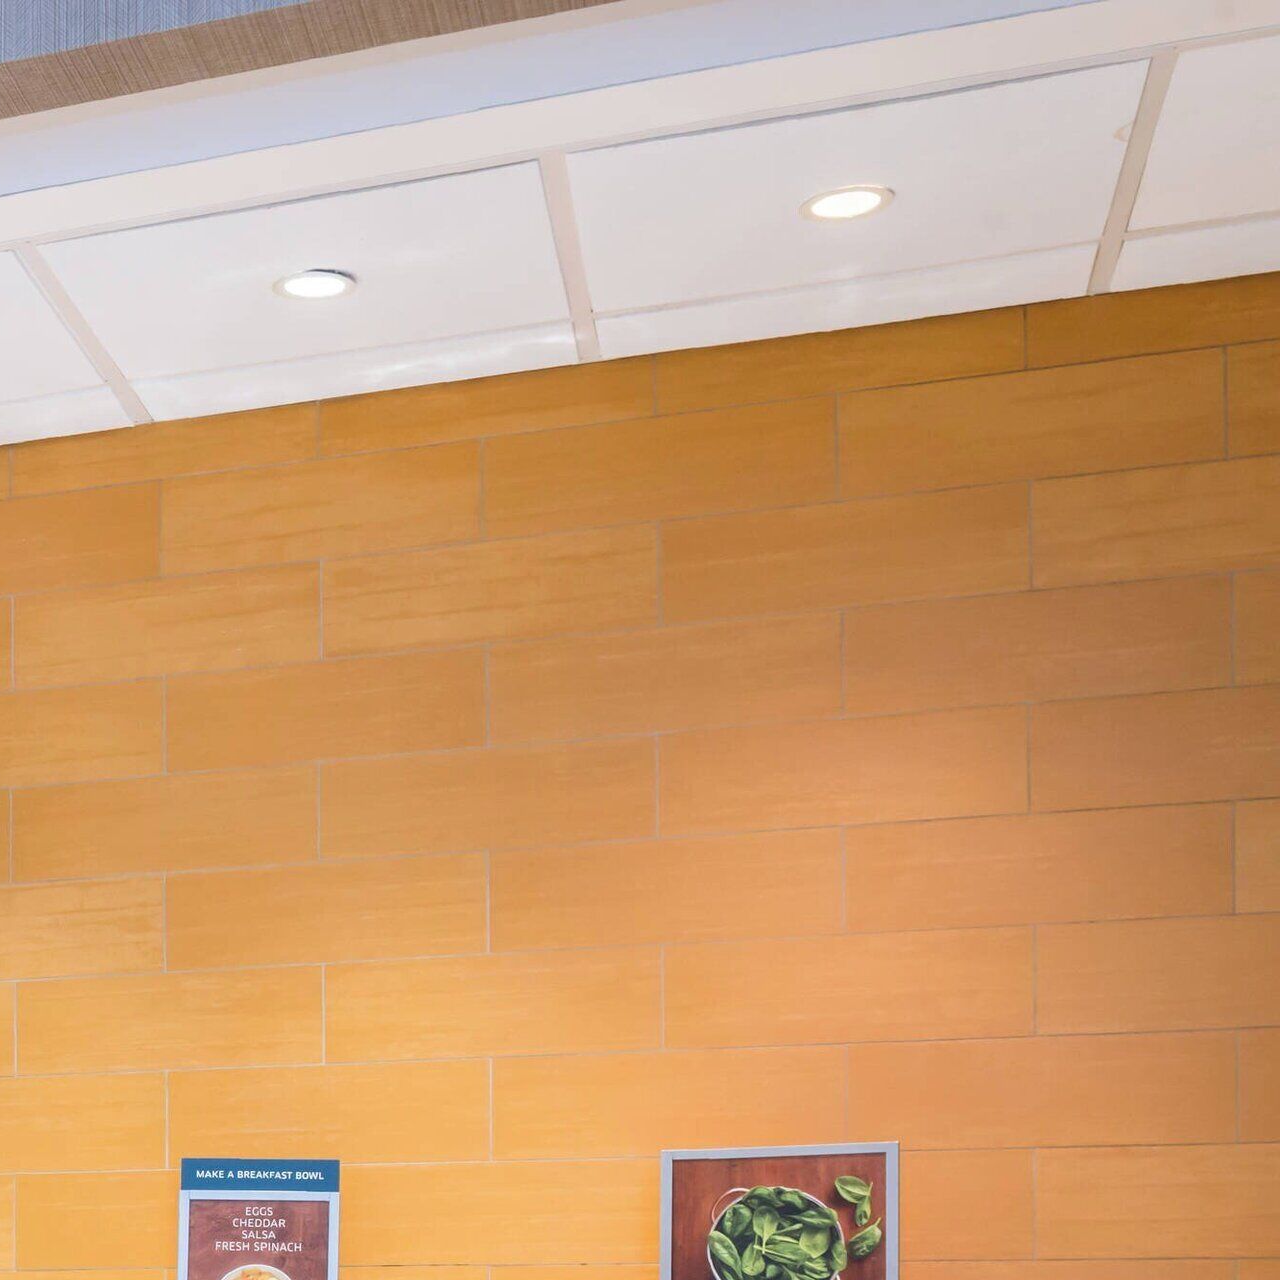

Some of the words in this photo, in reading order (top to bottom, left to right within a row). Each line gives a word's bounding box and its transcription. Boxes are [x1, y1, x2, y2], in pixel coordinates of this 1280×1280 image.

[196, 1170, 225, 1179] MAKE
[227, 1170, 234, 1179] A
[237, 1170, 292, 1180] BREAKFAST
[295, 1171, 324, 1180] BOWL
[245, 1206, 273, 1216] EGGS
[232, 1218, 286, 1228] CHEDDAR
[241, 1229, 276, 1239] SALSA
[215, 1241, 250, 1251] FRESH
[253, 1242, 302, 1252] SPINACH
